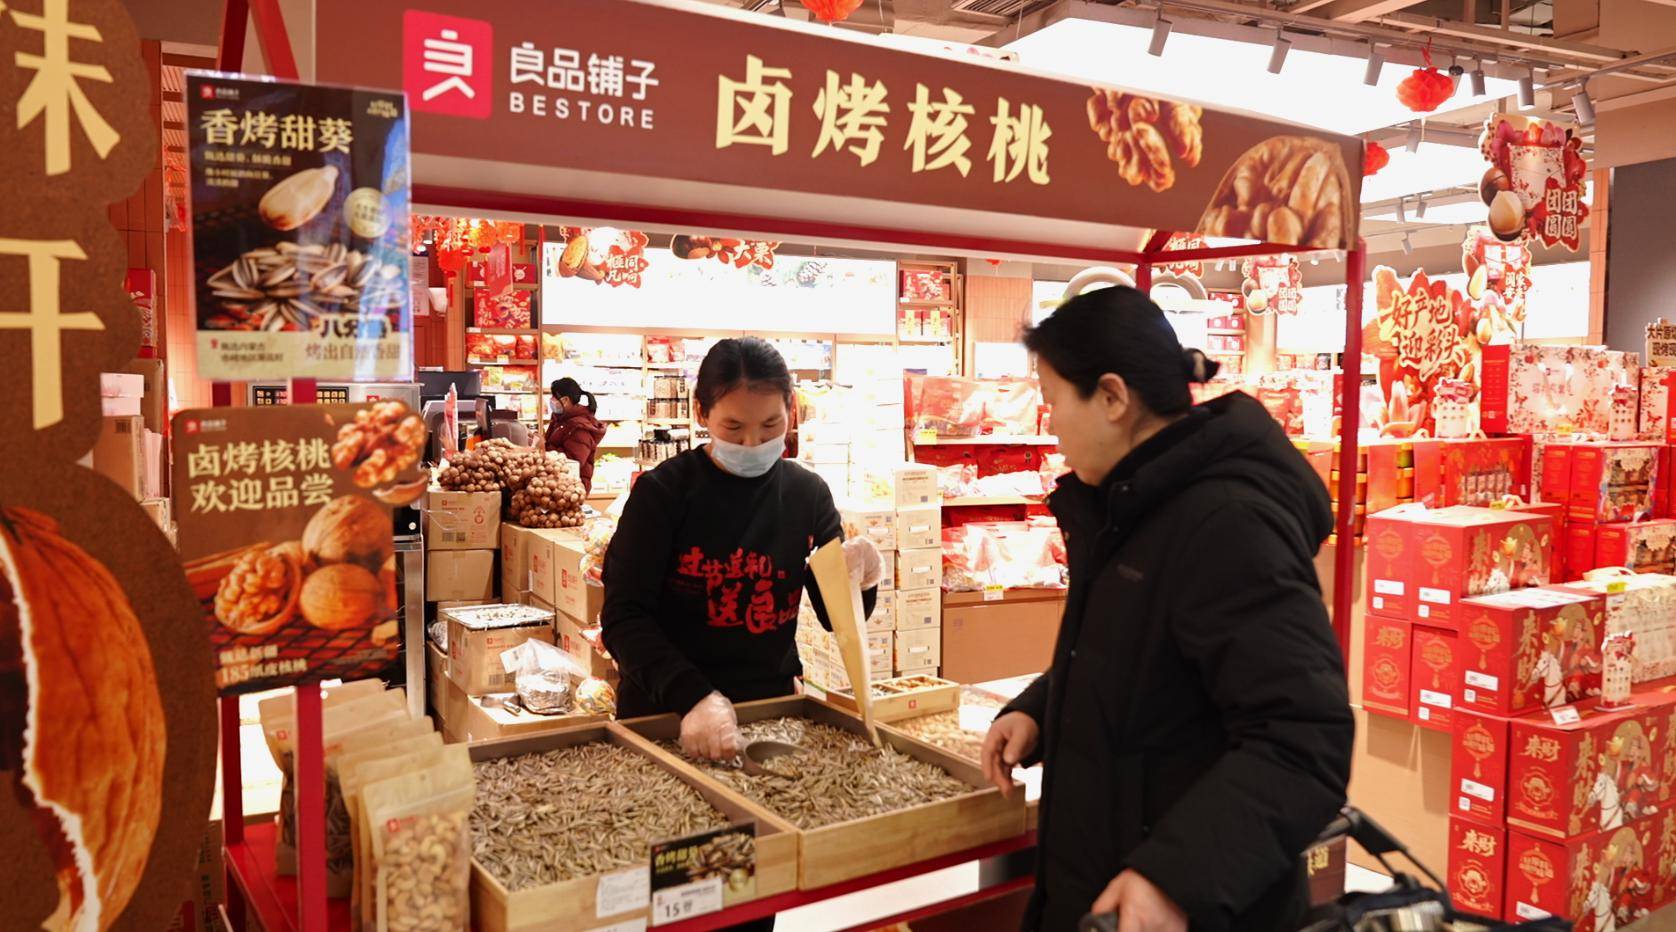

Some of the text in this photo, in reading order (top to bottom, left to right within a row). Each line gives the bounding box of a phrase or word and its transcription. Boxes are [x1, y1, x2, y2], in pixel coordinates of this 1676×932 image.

[511, 42, 659, 100] 良品铺子
[201, 108, 354, 154] 香烤甜葵
[510, 92, 654, 129] BESTORE
[715, 54, 1053, 185] 卤烤核桃
[1380, 288, 1453, 329] 好产地
[187, 437, 332, 479] 卤烤核桃
[190, 472, 335, 514] 欢迎品尝
[665, 903, 680, 918] 15
